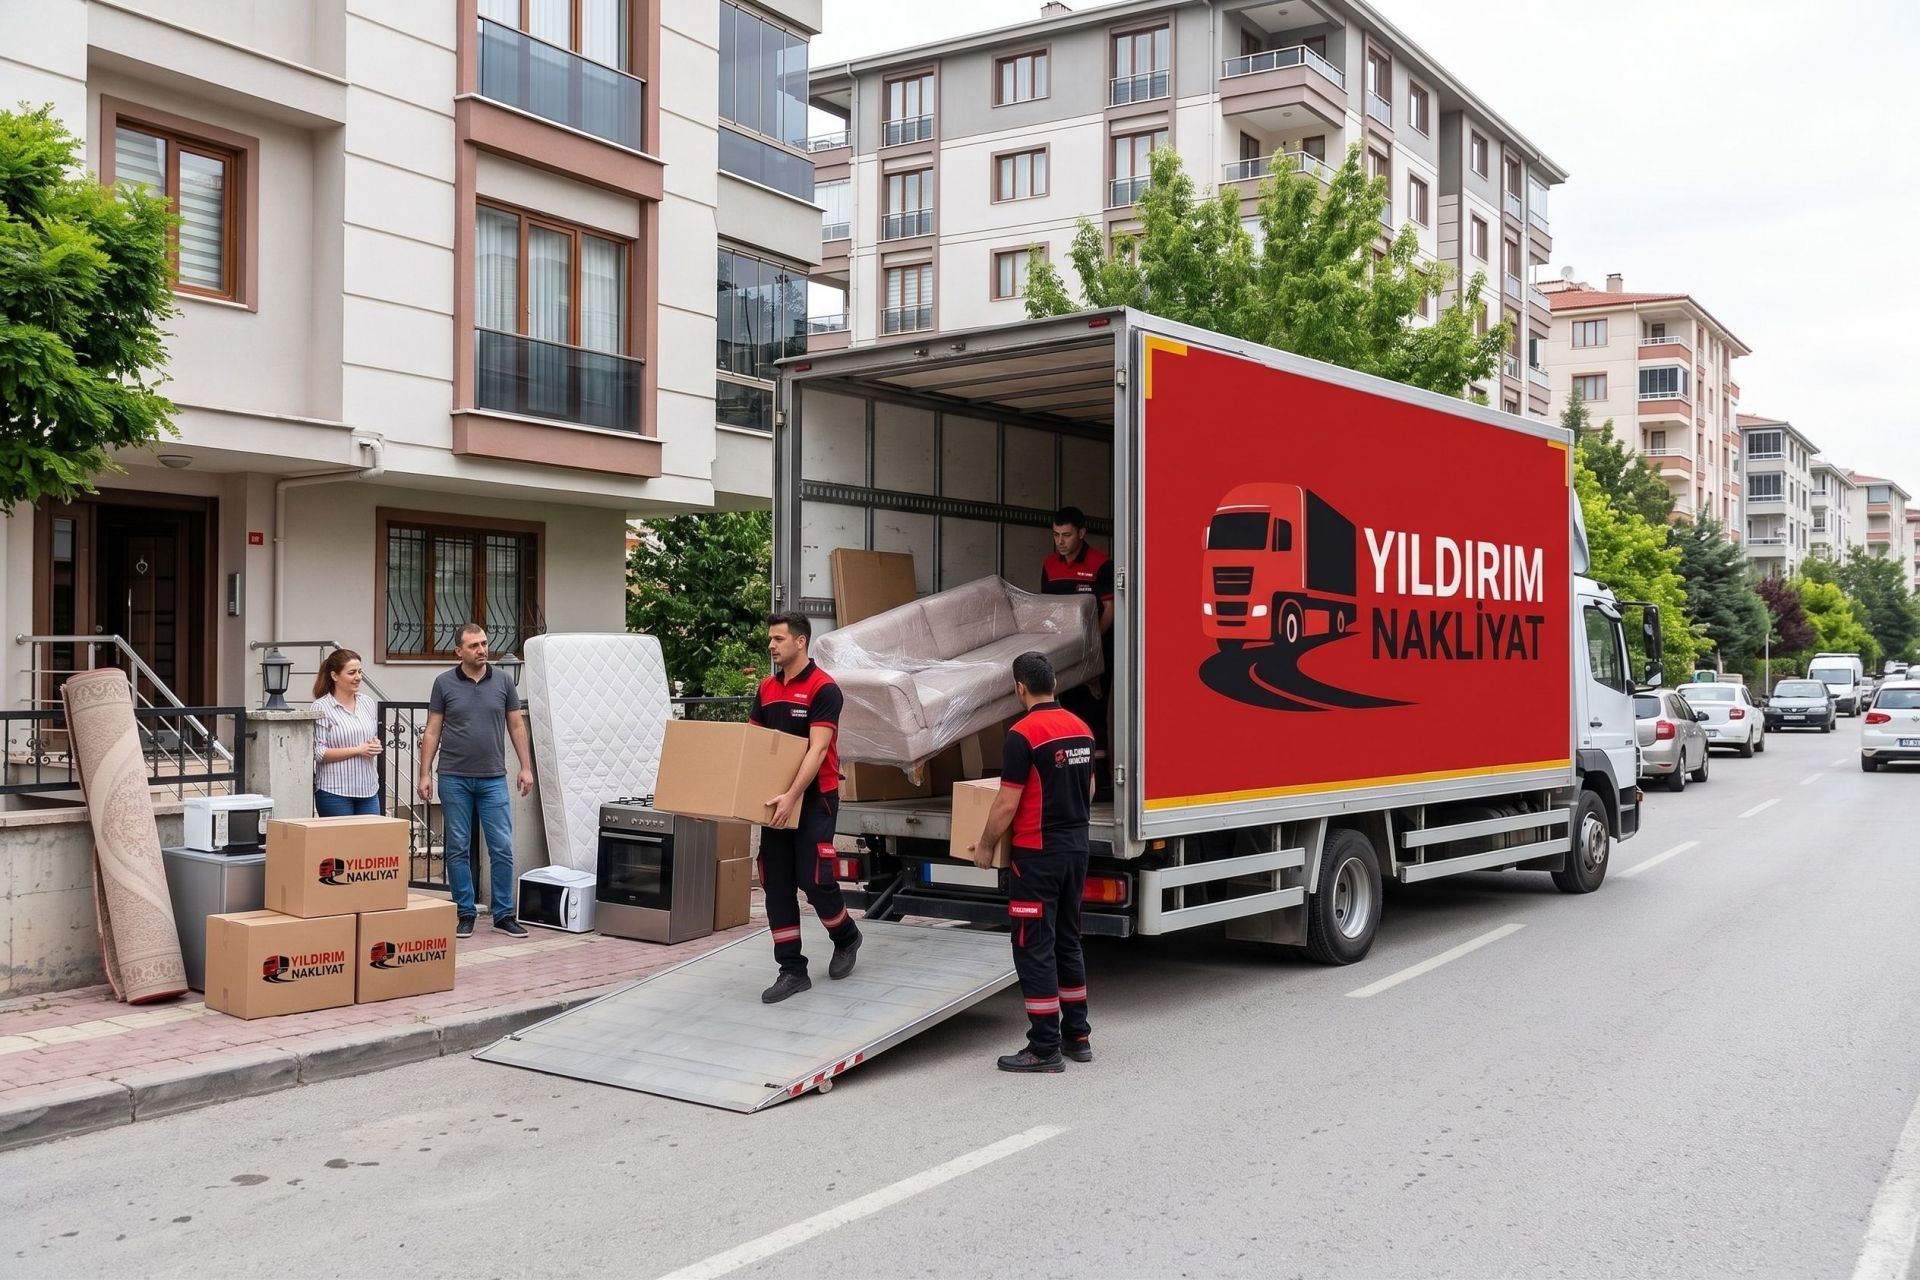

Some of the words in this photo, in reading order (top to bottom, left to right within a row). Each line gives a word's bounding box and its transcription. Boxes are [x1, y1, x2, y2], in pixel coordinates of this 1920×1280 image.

[1364, 527, 1544, 603] YILDIRIM
[1372, 601, 1545, 661] NAKLİYAT
[346, 856, 399, 870] YILDIRIM
[397, 938, 447, 953] YILDIRIM
[291, 951, 345, 967] YILDIRIM
